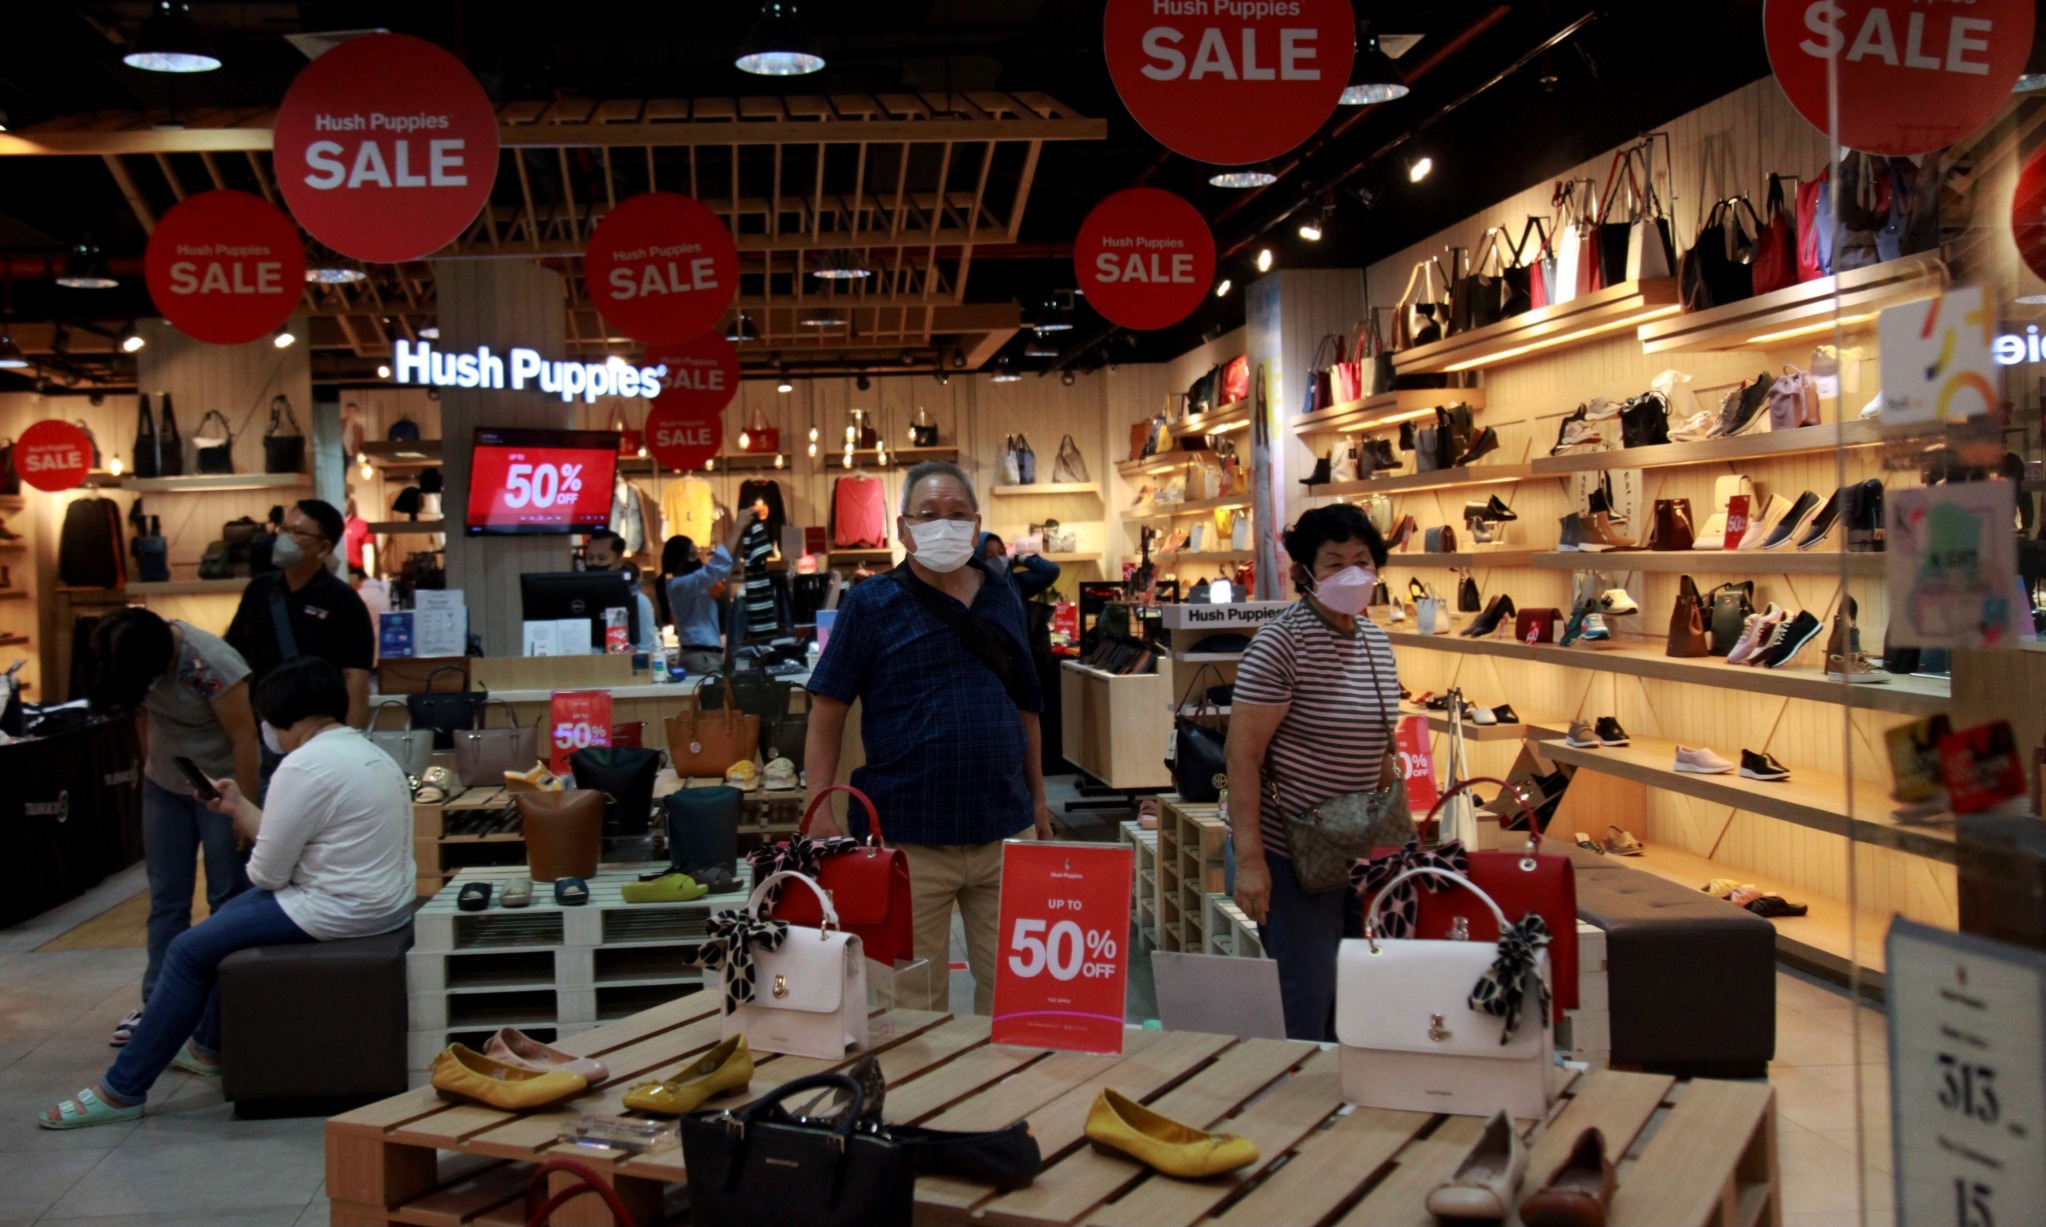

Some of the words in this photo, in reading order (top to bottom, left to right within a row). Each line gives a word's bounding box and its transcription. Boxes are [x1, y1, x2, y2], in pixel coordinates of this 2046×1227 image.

[1153, 0, 1208, 15] Hush
[1214, 0, 1300, 20] Puppies
[1799, 0, 1992, 76] SALE
[1140, 26, 1321, 81] SALE
[315, 113, 366, 131] Hush
[370, 112, 449, 132] Puppies
[304, 139, 468, 190] SALE
[177, 243, 213, 256] Hush
[215, 243, 271, 258] Puppies
[612, 248, 647, 261] Hush
[649, 243, 702, 258] Puppies
[1102, 236, 1134, 248] Hush
[1136, 236, 1185, 250] Puppies
[170, 262, 284, 294] SALE
[608, 257, 719, 300] SALE
[1095, 252, 1195, 283] SALE
[395, 339, 504, 389] Hush
[510, 347, 662, 403] Puppies
[656, 428, 712, 447] SALE
[25, 451, 83, 472] SALE
[504, 463, 583, 508] 50%
[556, 492, 579, 505] OFF
[1188, 609, 1225, 622] Hush
[555, 722, 607, 749] 50%
[1413, 769, 1428, 777] OFF
[1048, 899, 1065, 909] UP
[1067, 899, 1083, 911] TO
[1008, 918, 1117, 981] 50%
[1082, 963, 1117, 979] OFF
